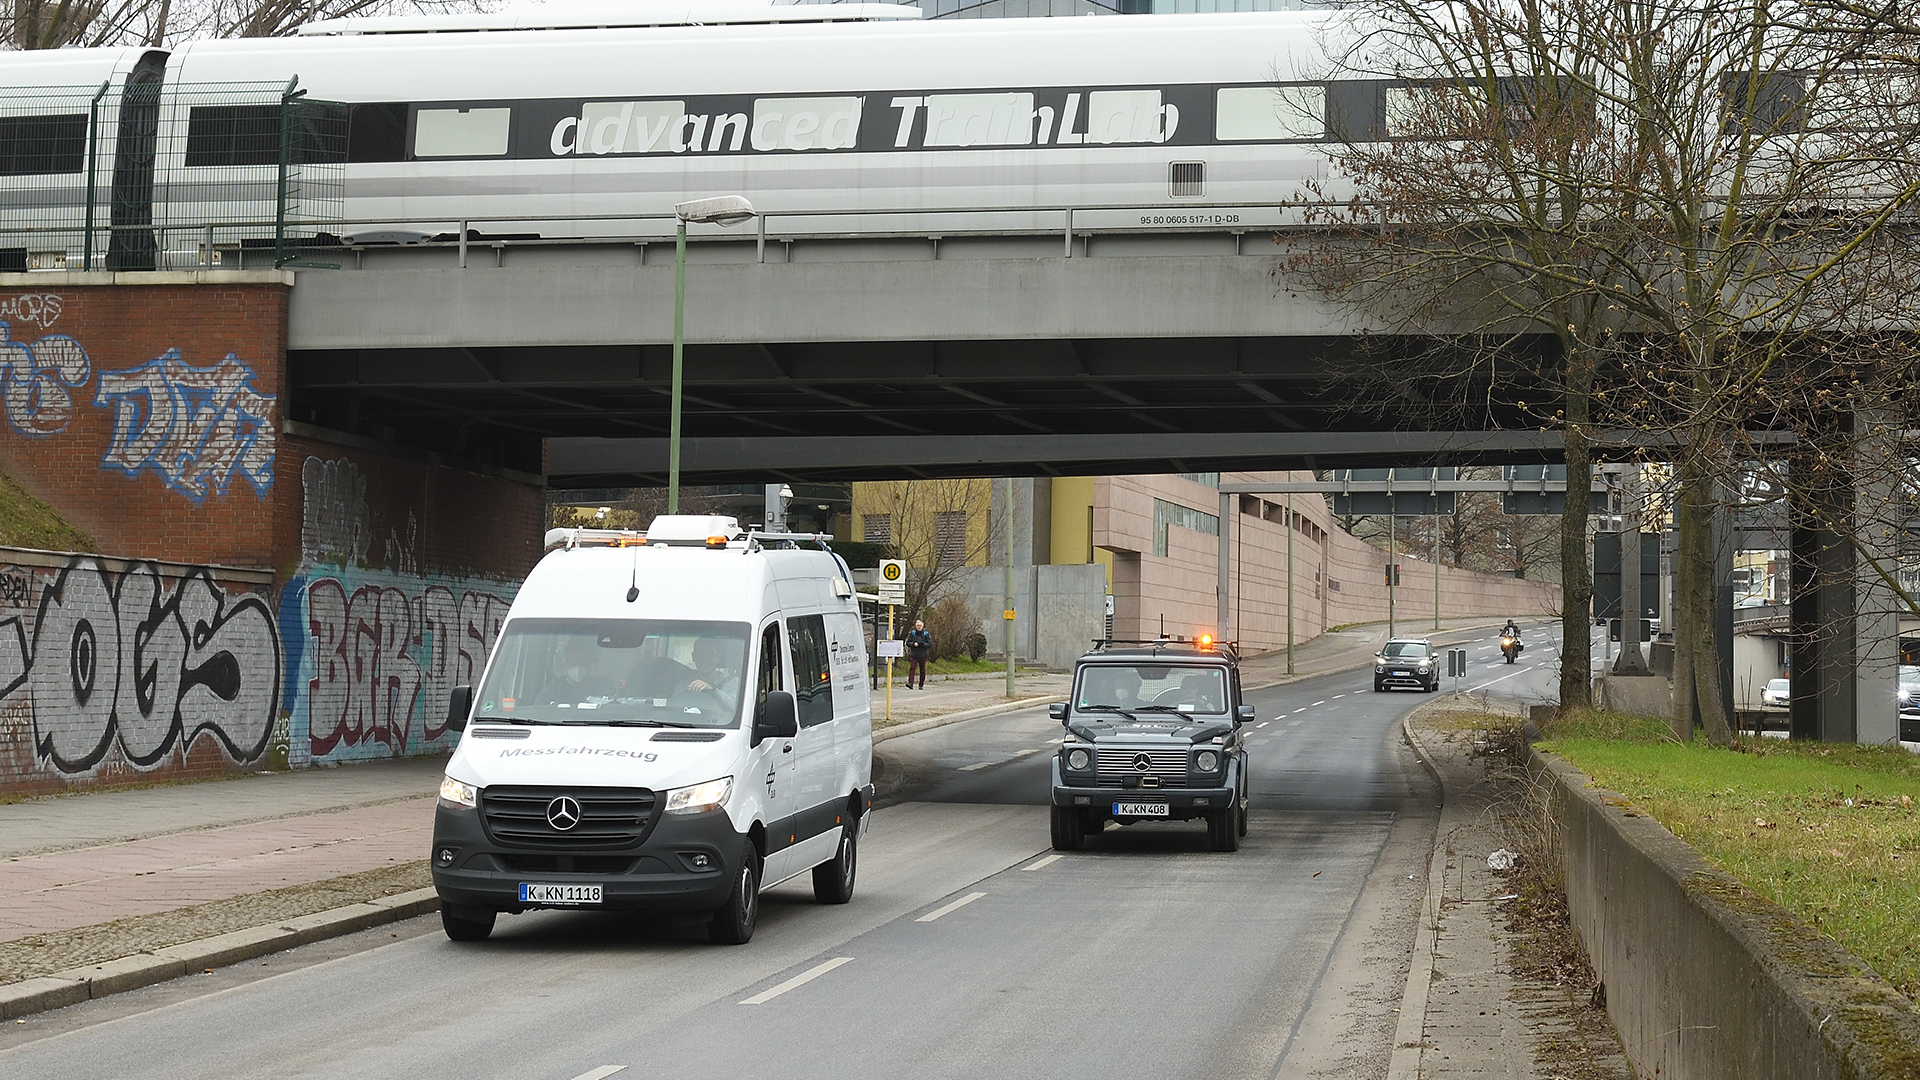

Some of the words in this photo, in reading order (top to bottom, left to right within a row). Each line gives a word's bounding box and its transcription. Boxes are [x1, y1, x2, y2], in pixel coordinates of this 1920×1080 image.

[550, 96, 866, 155] advanced
[890, 91, 1179, 147] TrainLab
[1140, 216, 1151, 224] 95
[1153, 216, 1164, 224] 80
[1166, 216, 1187, 224] 0605
[1189, 215, 1213, 224] 517-1
[1215, 214, 1240, 225] D-DB
[499, 745, 659, 763] Messfahrzeug
[1134, 804, 1146, 814] KN
[1148, 805, 1165, 814] 408
[528, 886, 537, 899] K
[545, 886, 563, 900] KN
[566, 887, 600, 901] 1118
